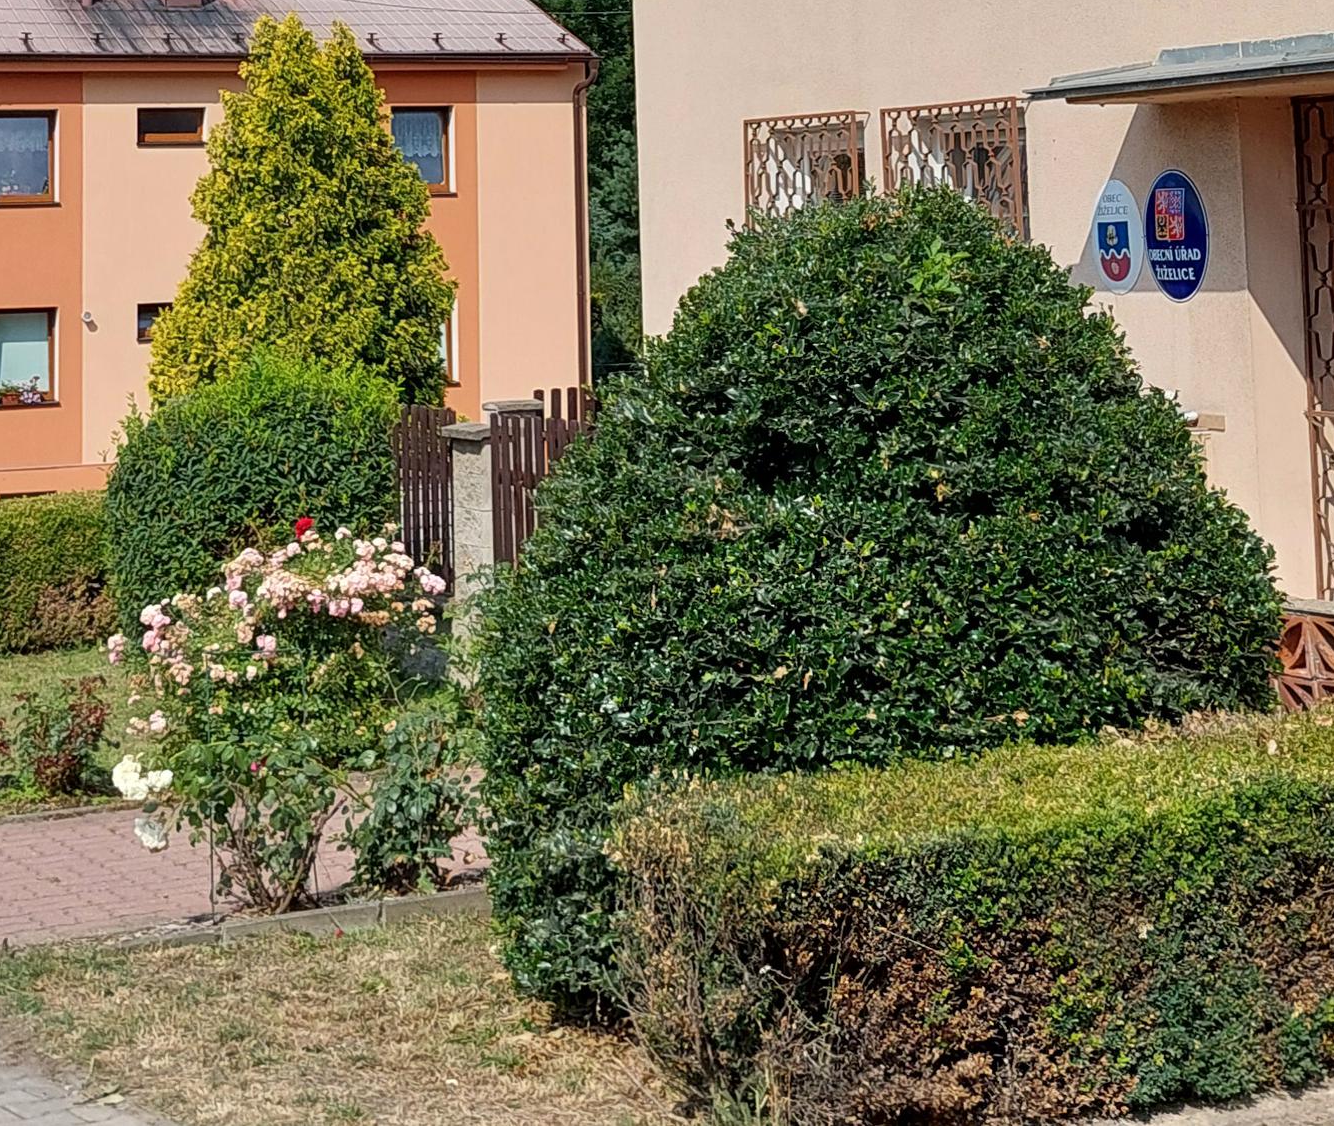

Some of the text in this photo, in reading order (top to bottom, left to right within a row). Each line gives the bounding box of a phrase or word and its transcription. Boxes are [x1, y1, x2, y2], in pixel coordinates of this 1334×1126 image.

[1102, 193, 1122, 203] OBEC
[1148, 245, 1202, 261] OBECNÍ ÚŘAD
[1155, 264, 1196, 281] ŽIŽELICE
